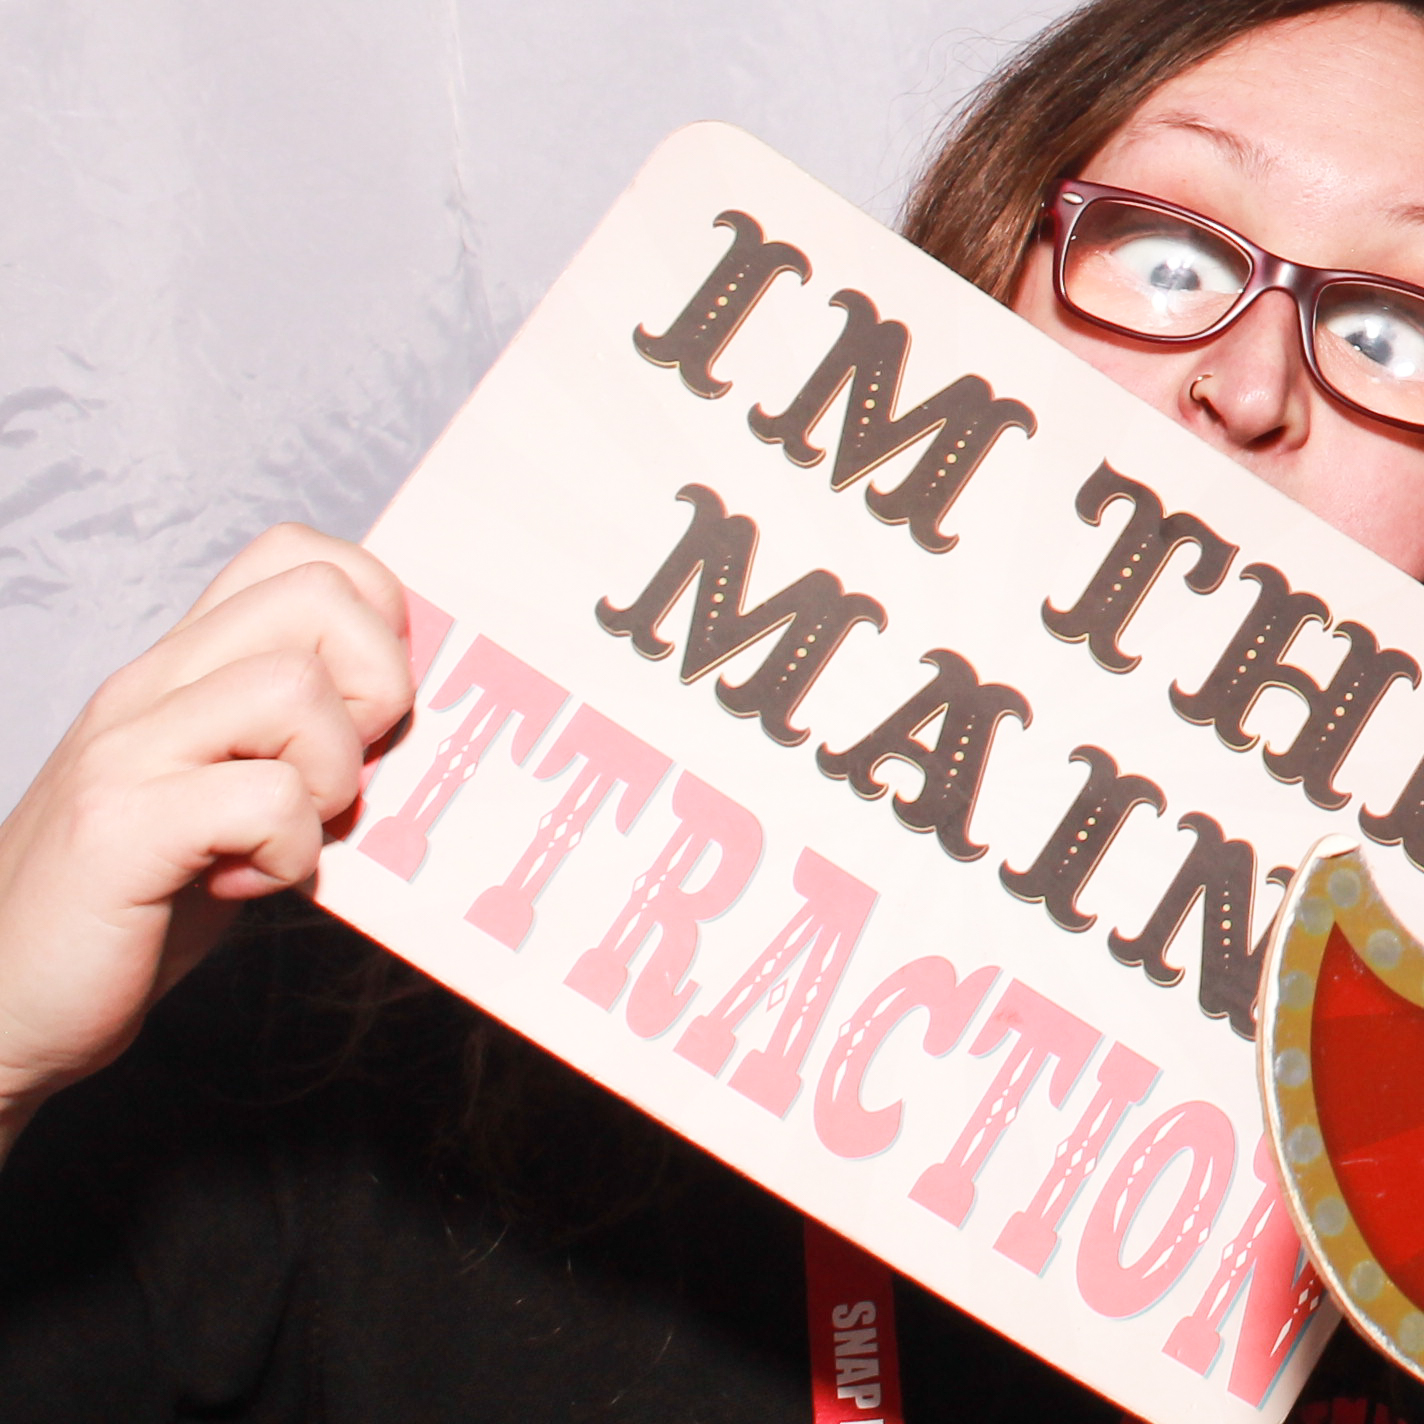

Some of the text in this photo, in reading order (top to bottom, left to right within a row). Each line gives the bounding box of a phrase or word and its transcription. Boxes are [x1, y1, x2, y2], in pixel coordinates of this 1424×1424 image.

[632, 207, 1037, 555] IM
[595, 482, 1298, 1042] MAIN
[831, 1300, 882, 1410] SNAP
